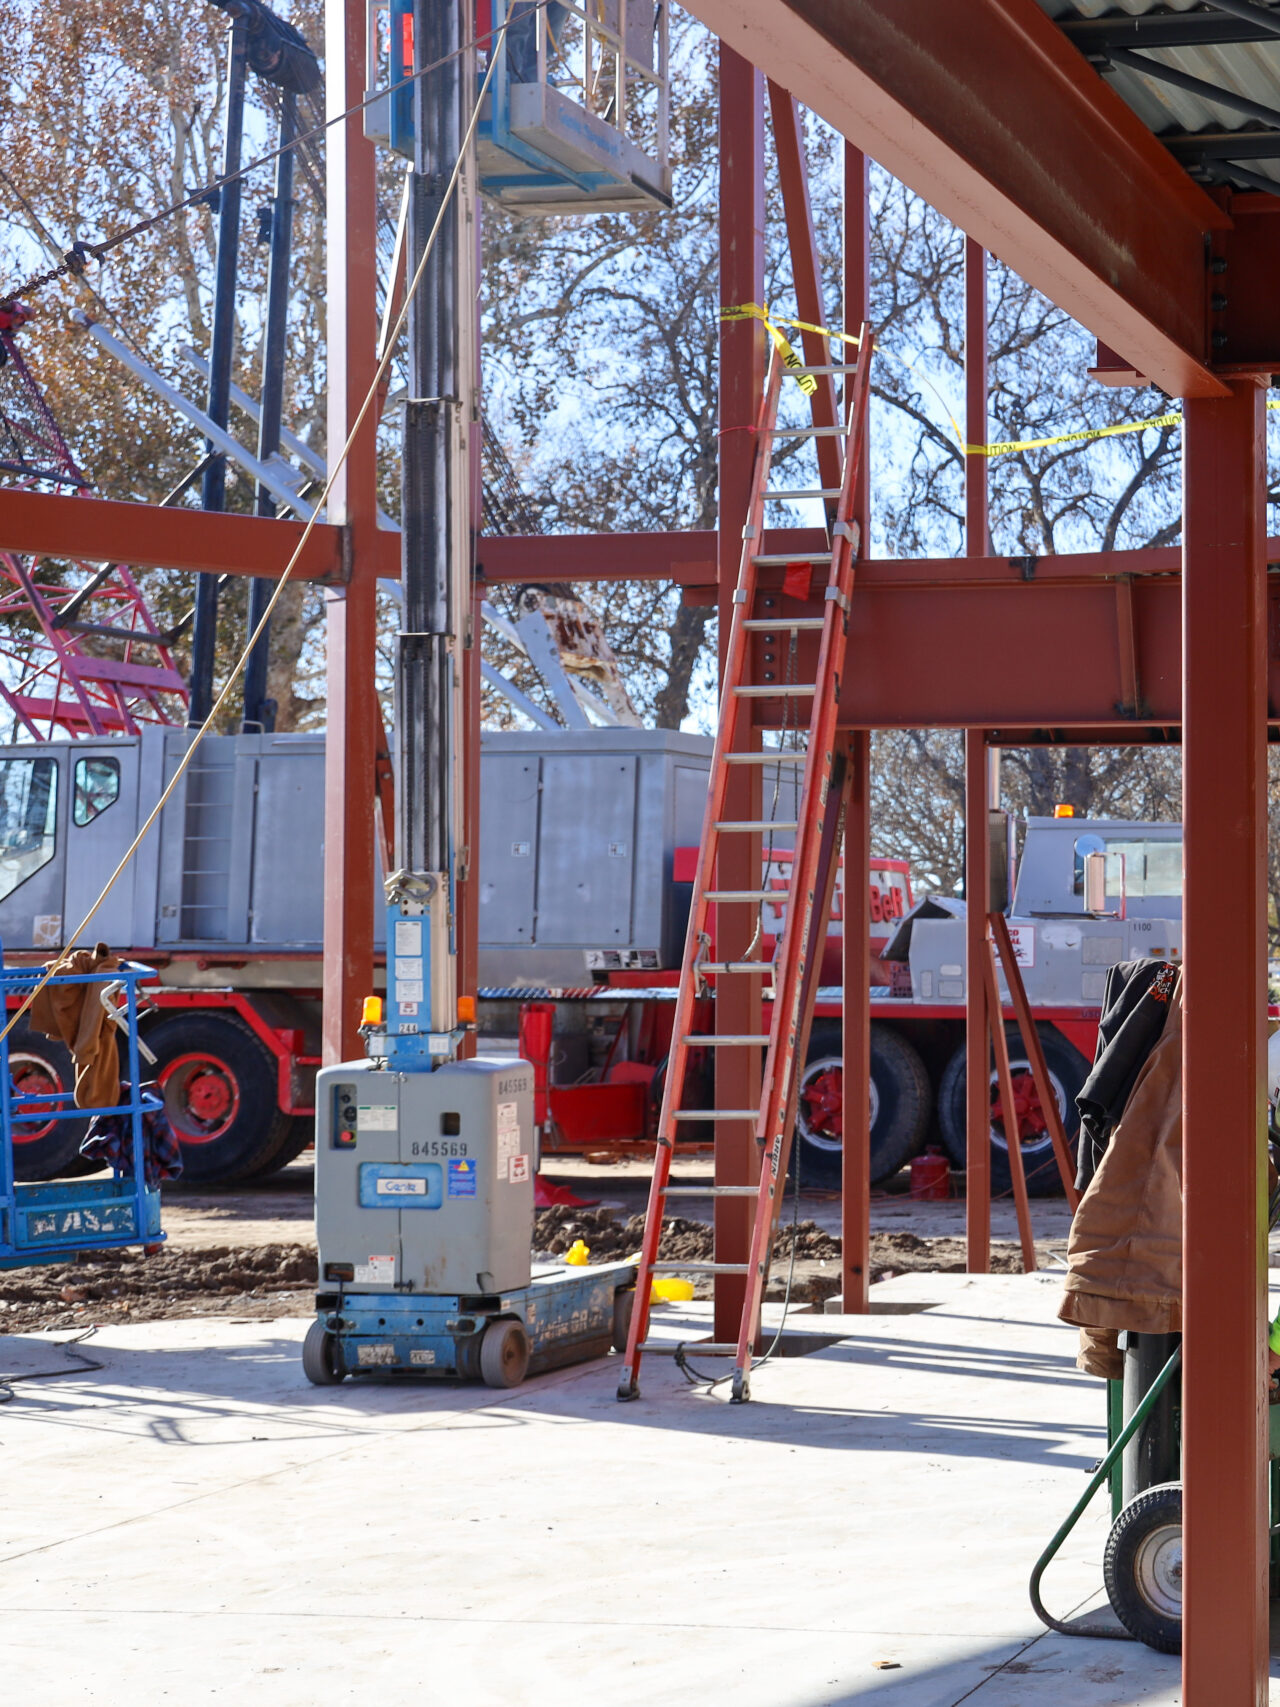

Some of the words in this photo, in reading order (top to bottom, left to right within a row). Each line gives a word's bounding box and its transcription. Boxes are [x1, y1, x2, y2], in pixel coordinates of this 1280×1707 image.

[1132, 922, 1152, 932] 1100
[400, 1024, 417, 1034] 244
[498, 1078, 528, 1096] 845569
[411, 1141, 468, 1157] 845569
